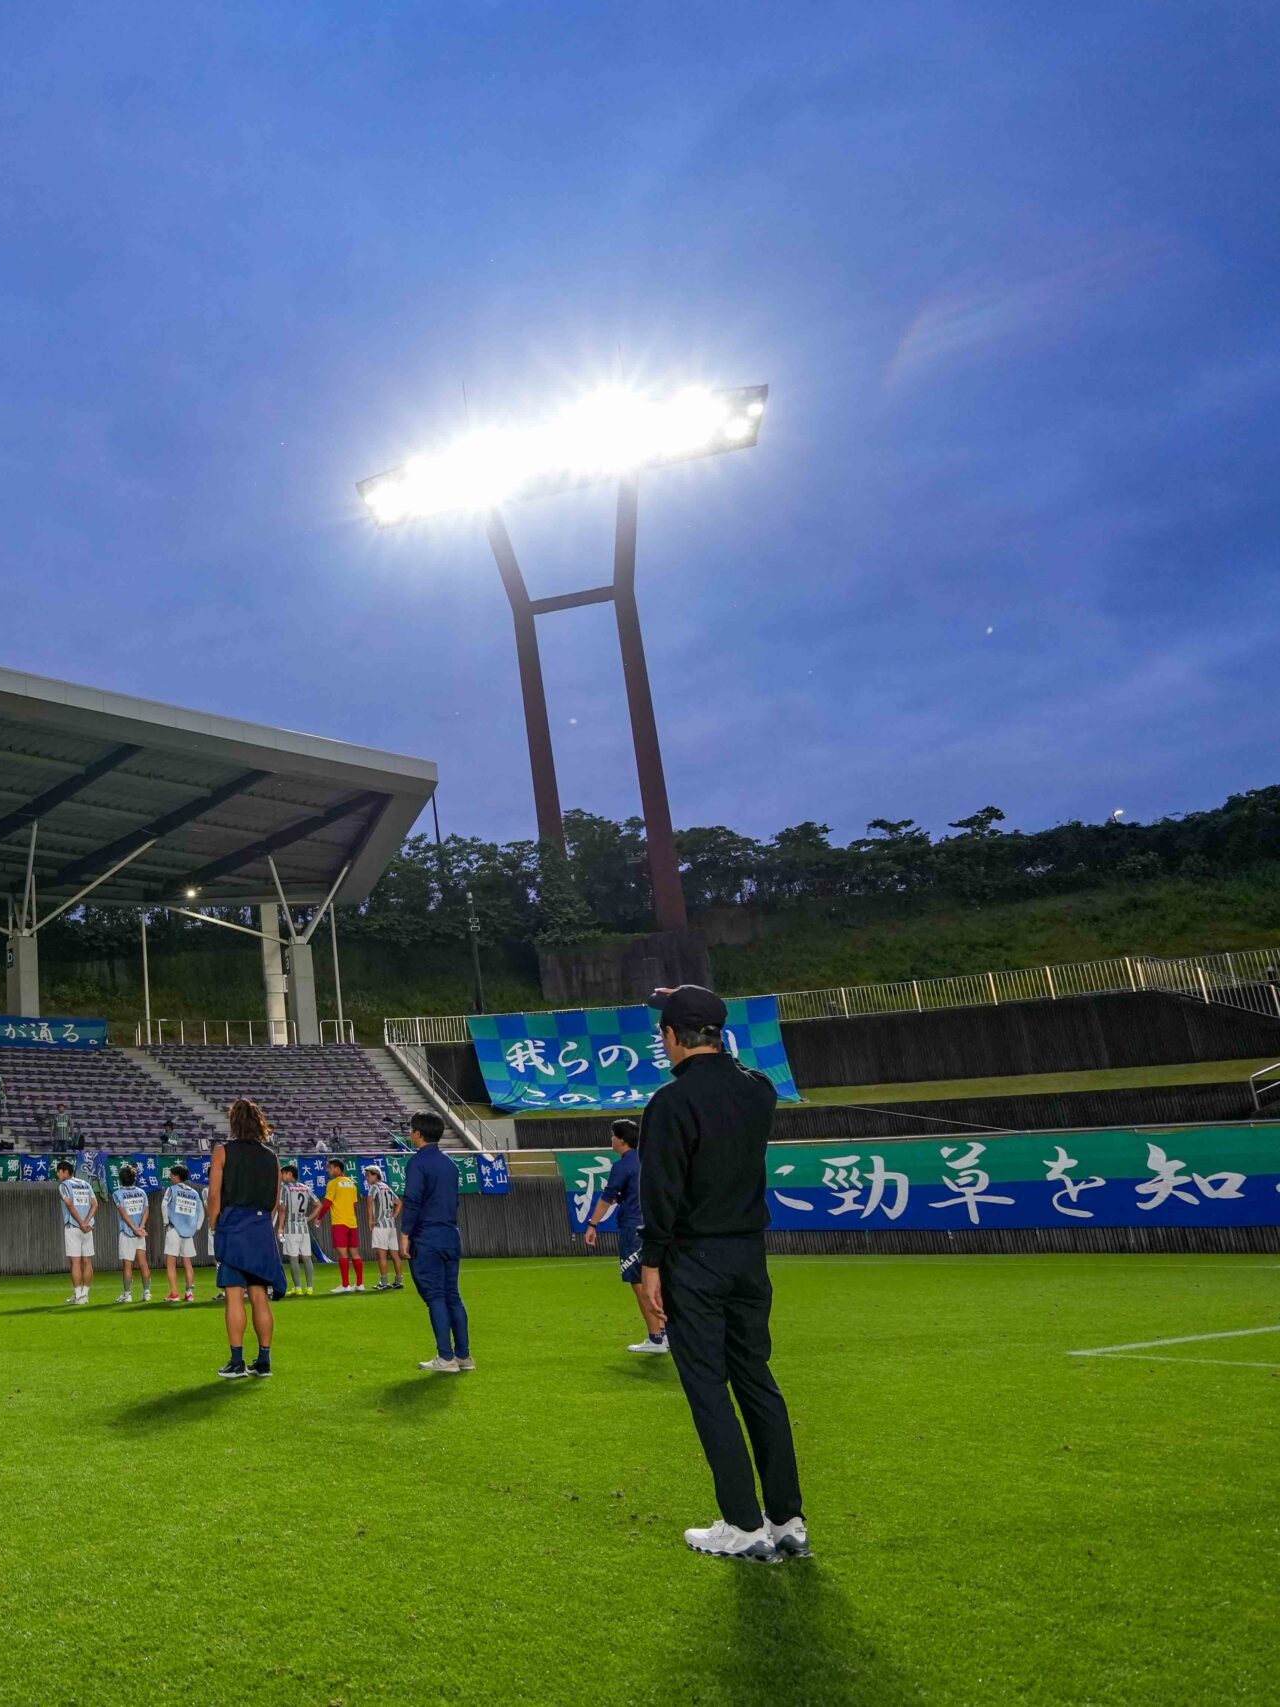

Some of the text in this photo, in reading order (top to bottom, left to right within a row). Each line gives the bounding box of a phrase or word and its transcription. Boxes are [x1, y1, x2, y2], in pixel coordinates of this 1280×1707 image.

[506, 1029, 738, 1077] 我らの
[297, 1193, 305, 1213] 2
